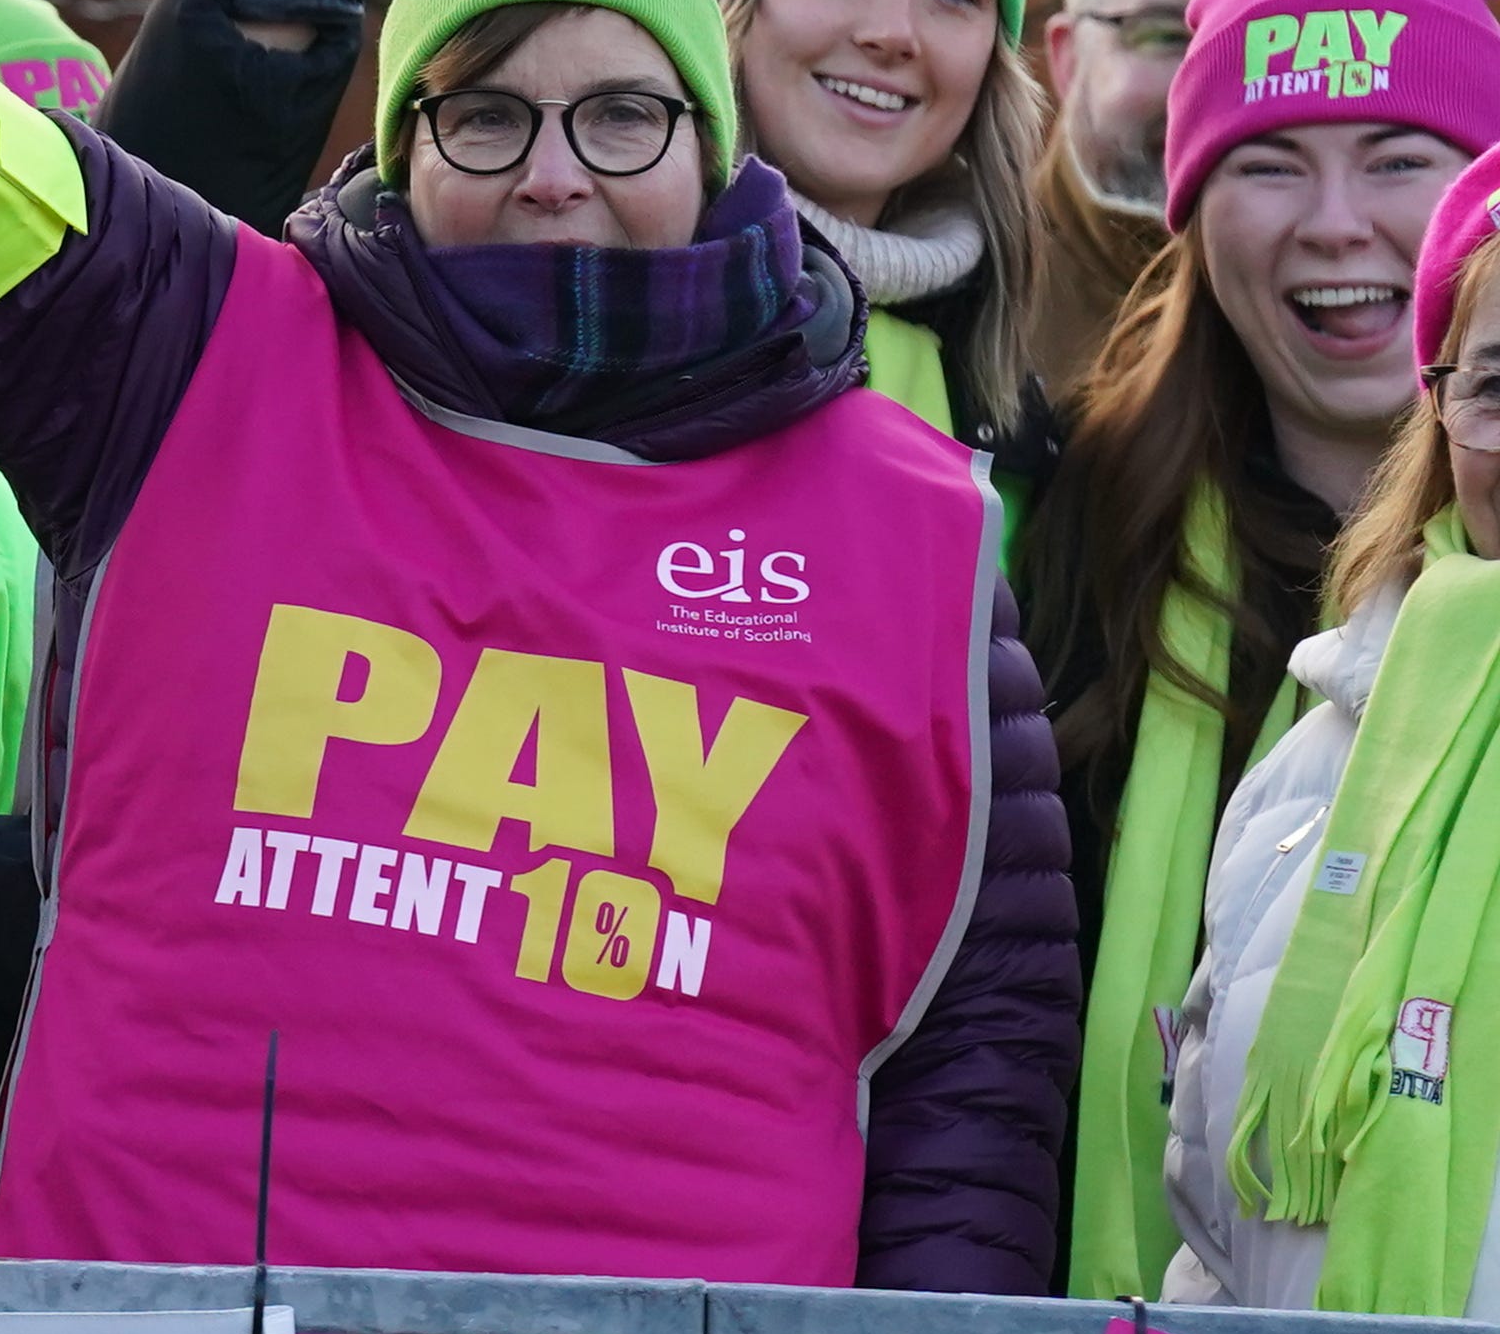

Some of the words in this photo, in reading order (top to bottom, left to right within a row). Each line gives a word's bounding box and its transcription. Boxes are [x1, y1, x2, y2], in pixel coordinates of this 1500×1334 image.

[1244, 9, 1408, 85] PAY
[656, 529, 810, 604] eis
[656, 620, 720, 637] Institute
[724, 628, 740, 639] of
[744, 627, 812, 643] Scotland
[670, 605, 700, 621] The
[704, 610, 798, 625] Educational
[233, 603, 810, 907] PAY
